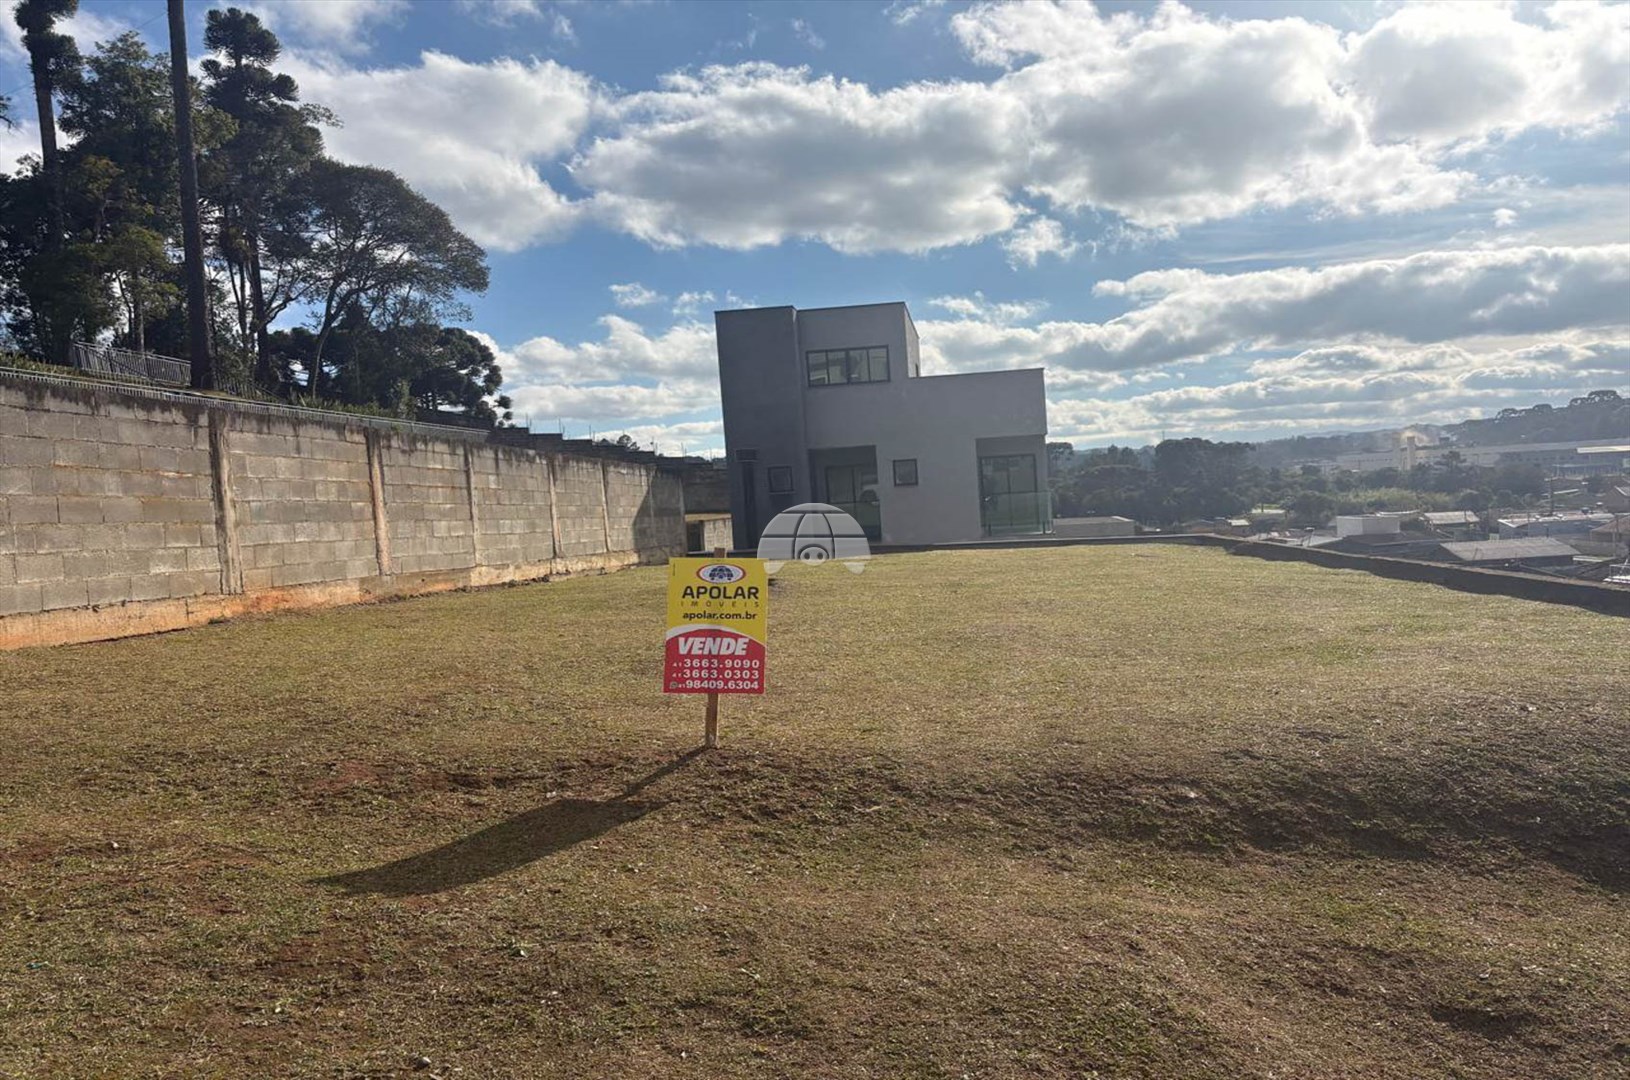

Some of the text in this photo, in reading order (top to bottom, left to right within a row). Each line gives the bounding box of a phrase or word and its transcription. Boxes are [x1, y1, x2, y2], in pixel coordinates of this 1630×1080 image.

[682, 586, 759, 600] APOLAR
[683, 610, 758, 621] apolar.com.br
[678, 637, 750, 655] VENDE
[684, 658, 760, 669] 3663.9090
[683, 669, 759, 679] 3663.0303
[686, 680, 759, 690] 98409.6304
